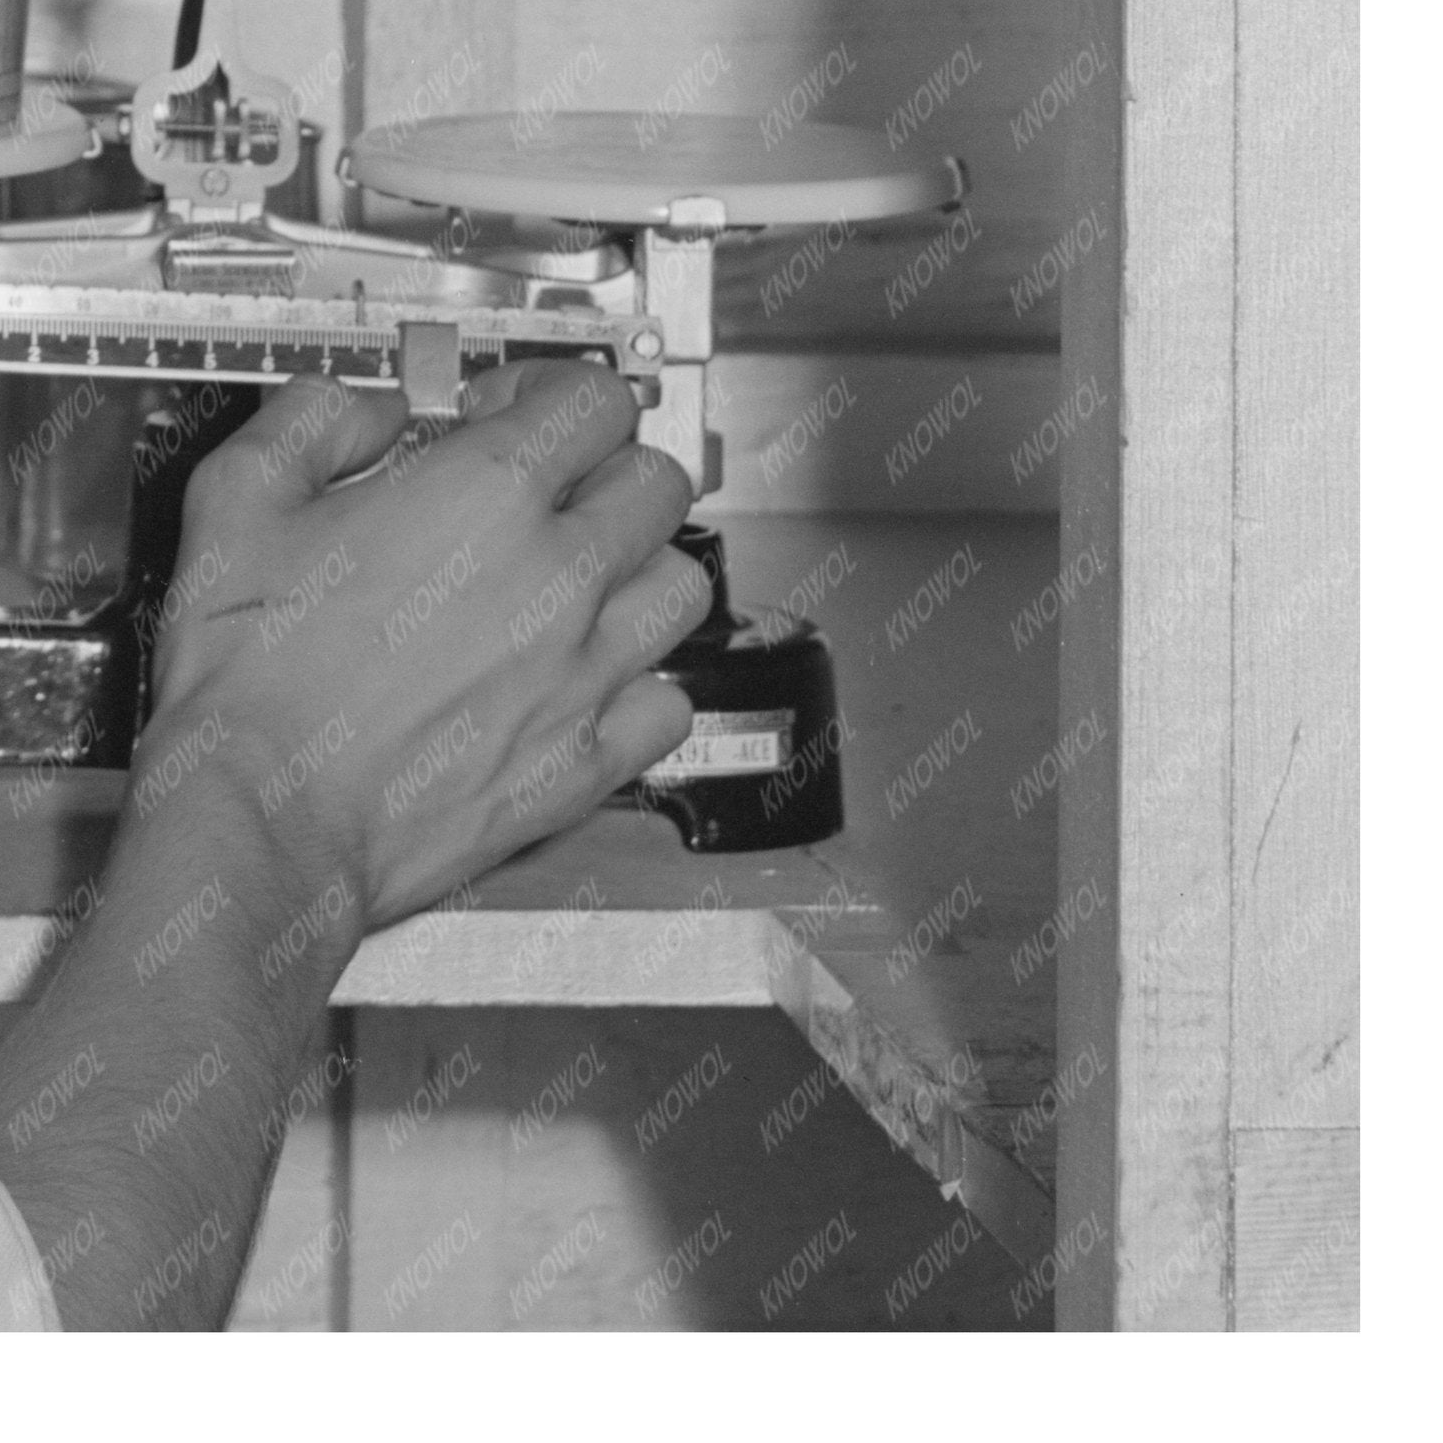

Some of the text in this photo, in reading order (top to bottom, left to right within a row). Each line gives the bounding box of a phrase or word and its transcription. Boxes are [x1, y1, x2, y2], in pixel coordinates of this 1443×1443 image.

[27, 345, 42, 363] 2
[86, 347, 100, 366] 3
[145, 350, 160, 368] 4
[204, 352, 217, 371] 5
[261, 355, 276, 373] 6
[319, 357, 334, 375] 7
[378, 359, 393, 378] 8
